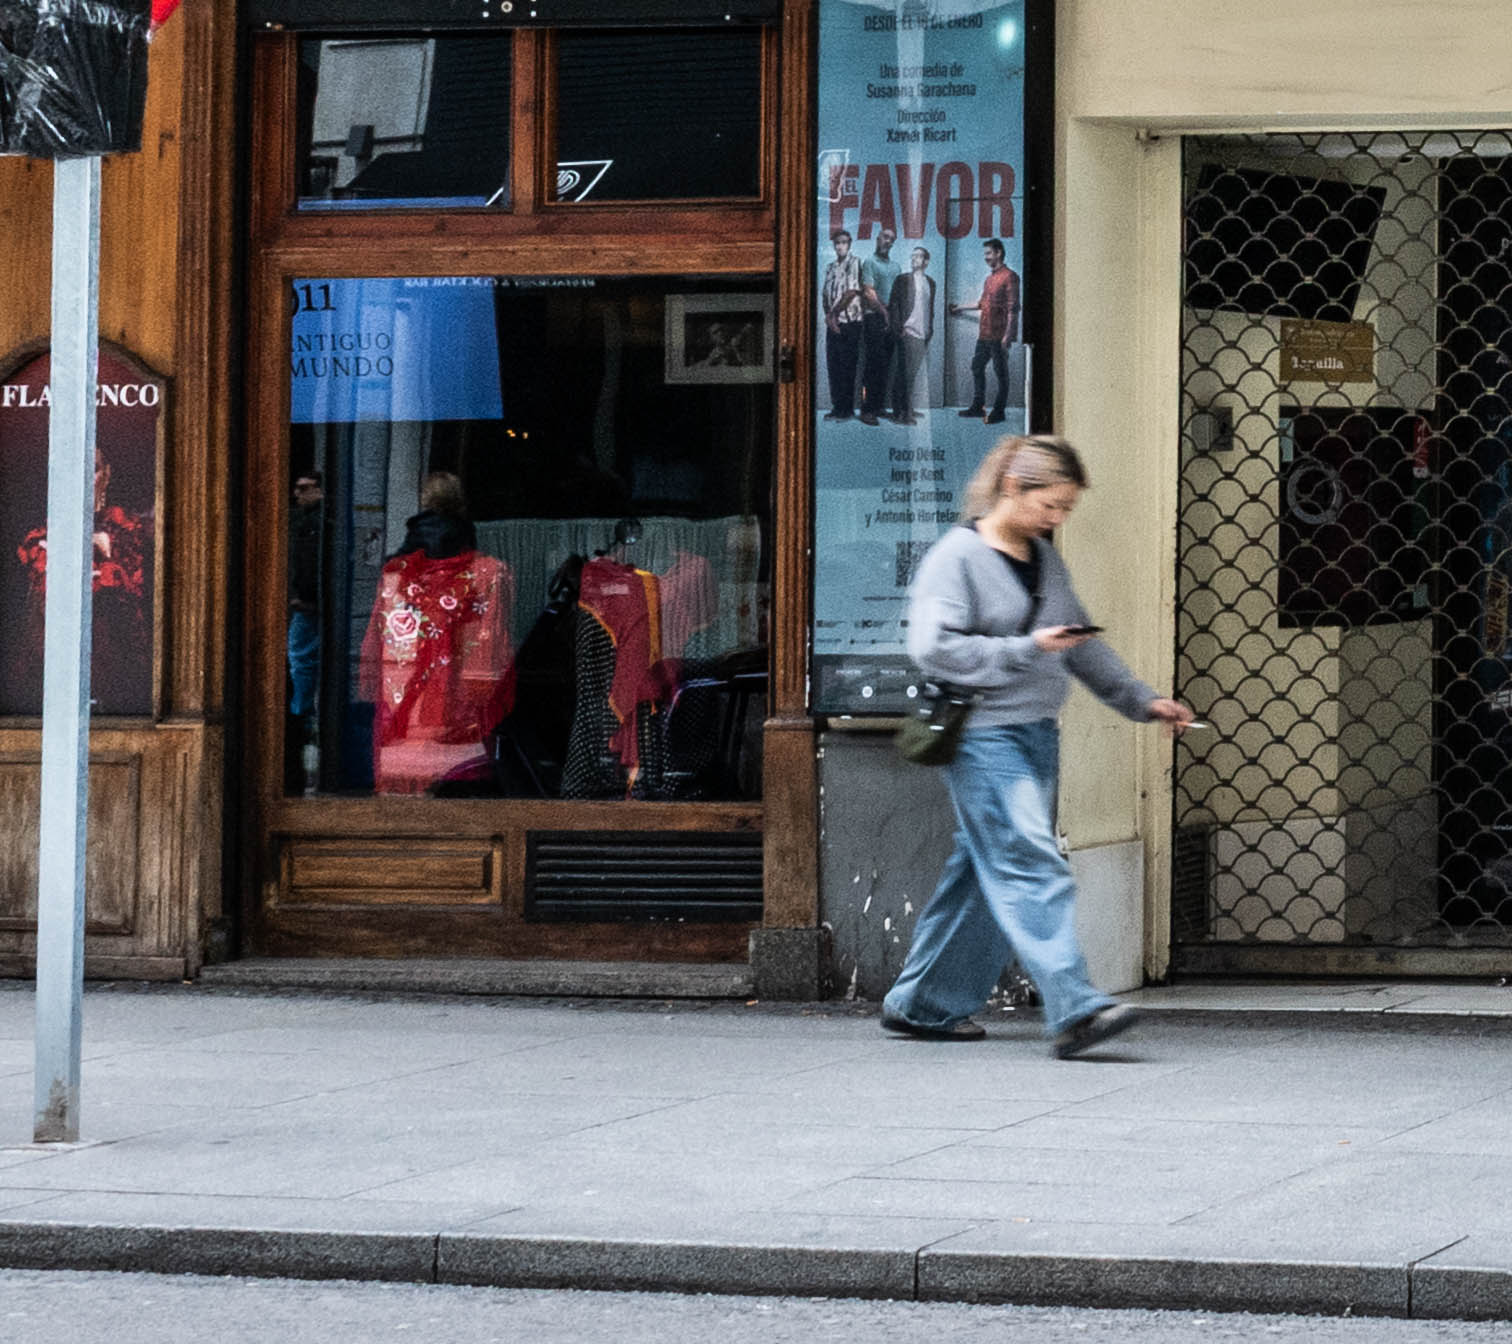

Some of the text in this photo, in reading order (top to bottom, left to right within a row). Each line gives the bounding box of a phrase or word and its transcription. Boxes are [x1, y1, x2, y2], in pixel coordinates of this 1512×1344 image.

[829, 161, 1015, 240] FAVOR
[290, 332, 390, 353] NTIGUO
[1, 384, 160, 408] FLANCO
